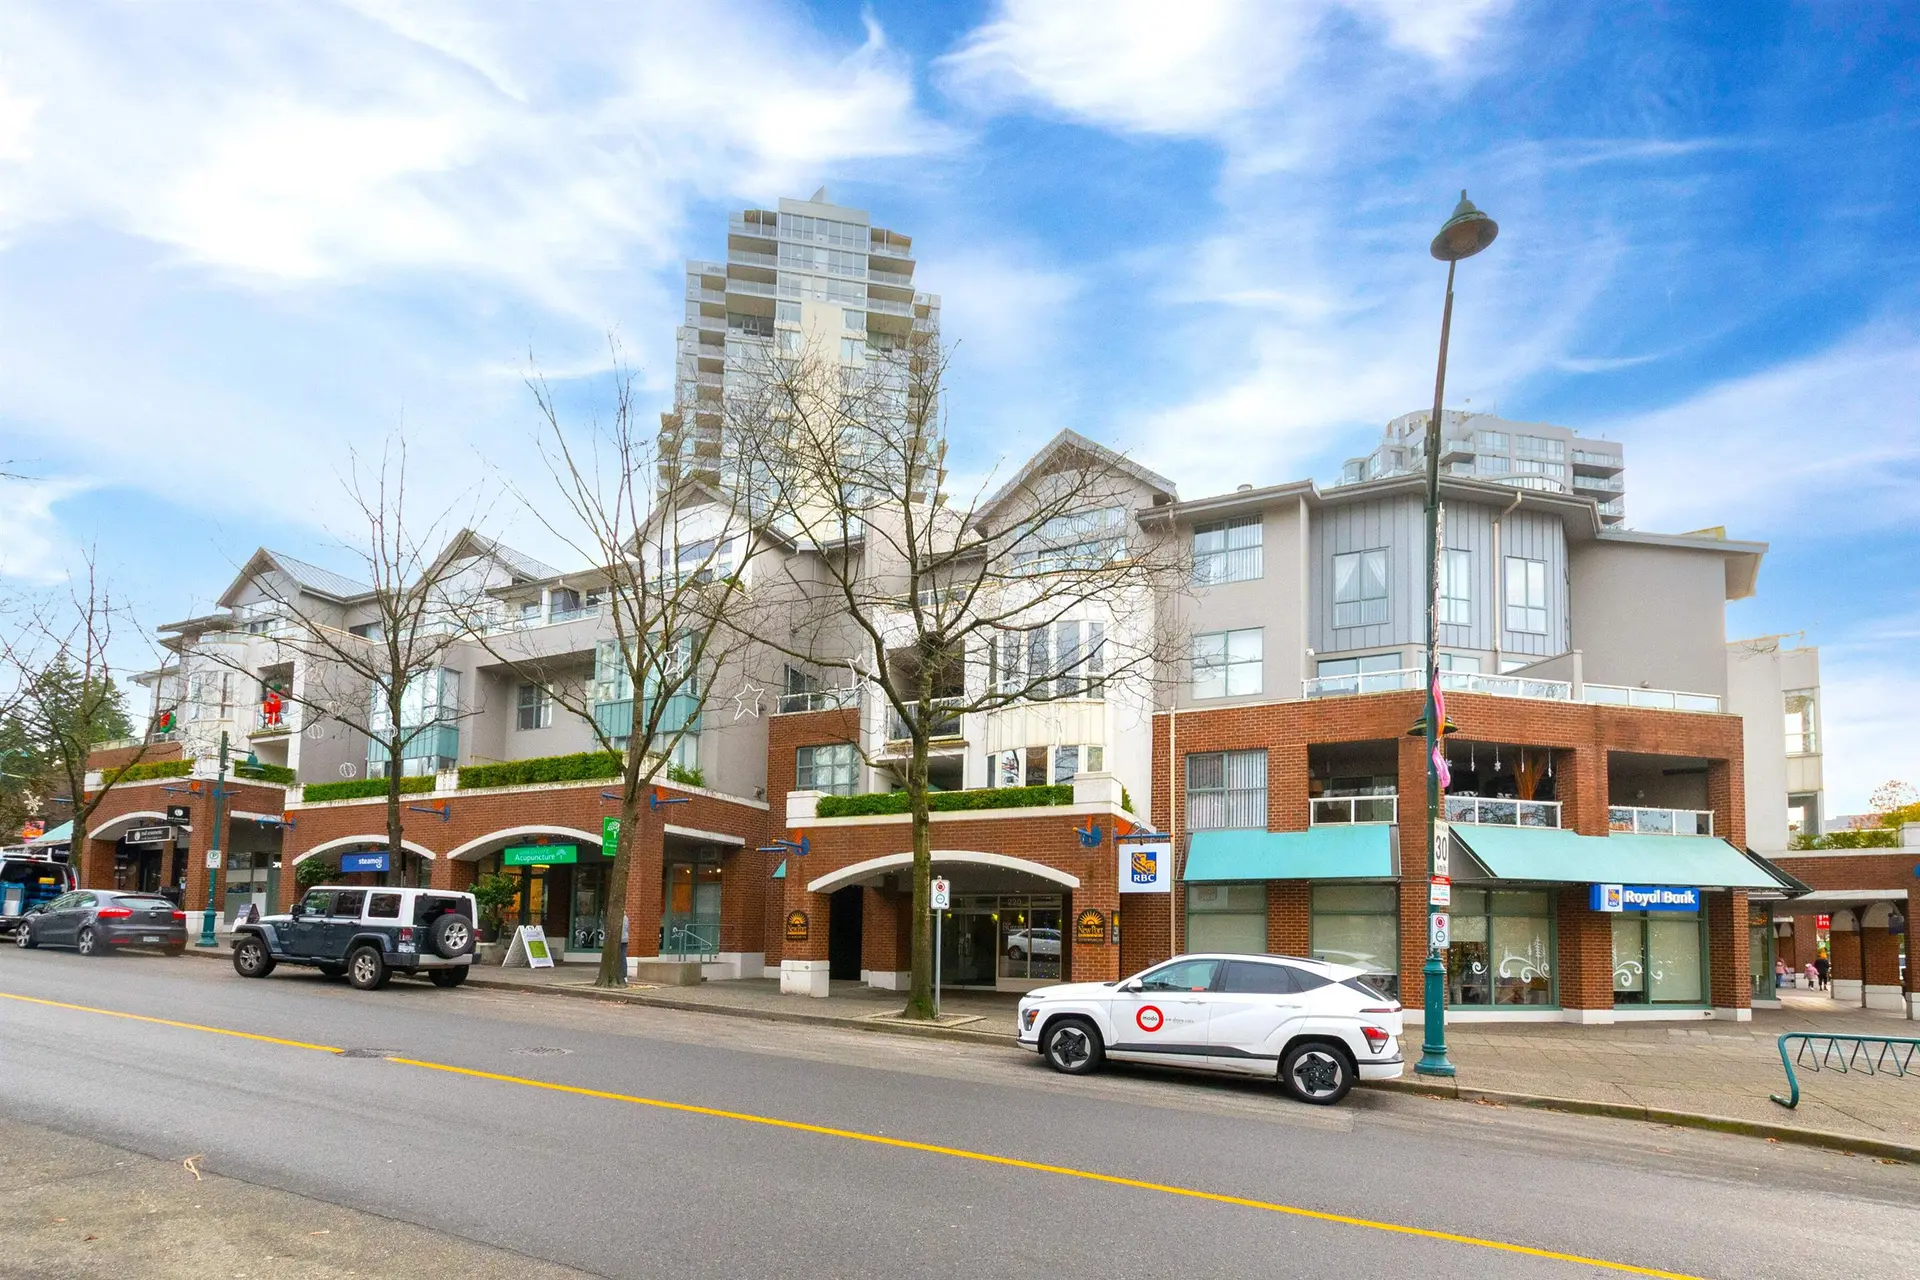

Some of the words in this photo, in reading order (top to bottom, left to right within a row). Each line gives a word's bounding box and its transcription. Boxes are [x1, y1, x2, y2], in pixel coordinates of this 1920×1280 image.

[1436, 835, 1447, 861] 30
[358, 857, 382, 869] steamoji
[514, 854, 556, 863] Acupuncture
[1133, 874, 1155, 882] RBC
[1624, 889, 1661, 907] Royal
[1663, 890, 1695, 904] Bank
